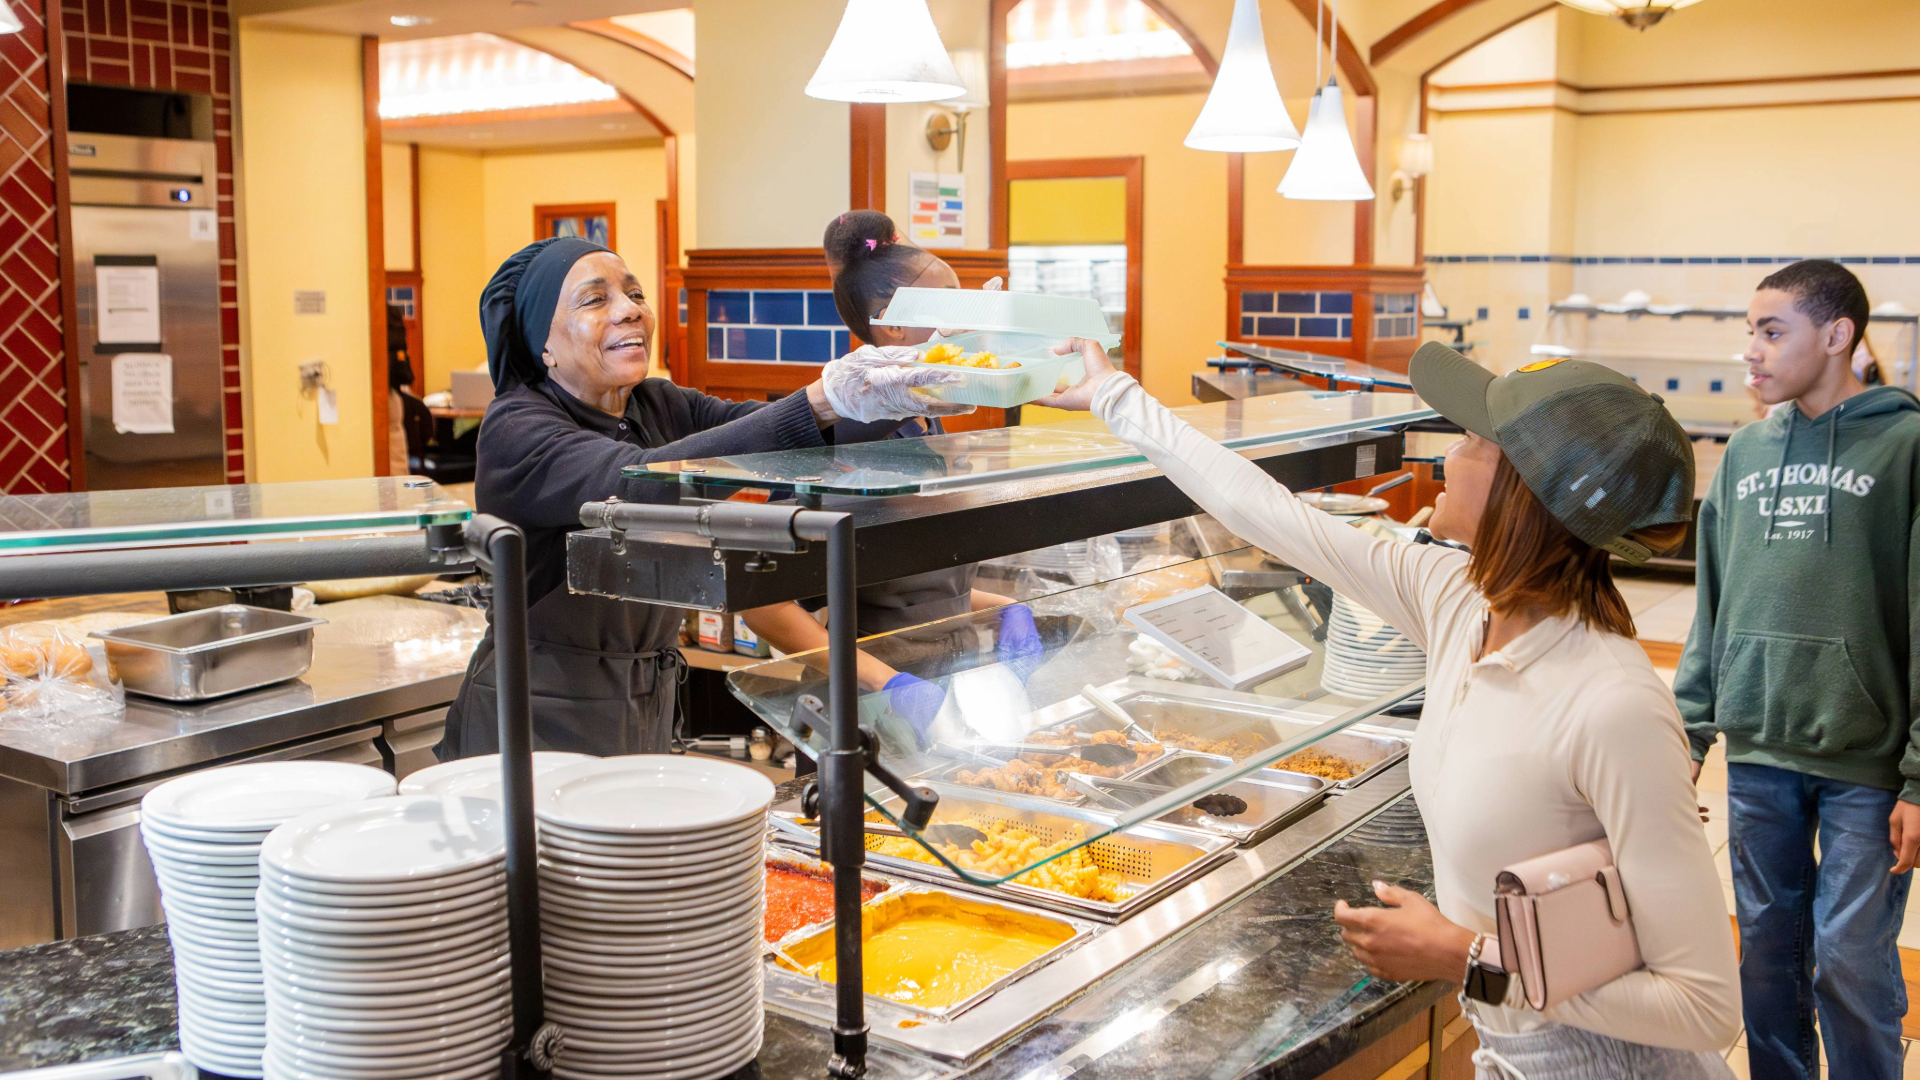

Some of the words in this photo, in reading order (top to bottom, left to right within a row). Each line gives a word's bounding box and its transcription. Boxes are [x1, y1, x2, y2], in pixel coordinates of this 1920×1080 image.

[1736, 471, 1766, 500] ST.
[1766, 463, 1876, 497] THOMAS
[1758, 495, 1829, 516] U.S.V.I
[1787, 529, 1815, 540] 1917
